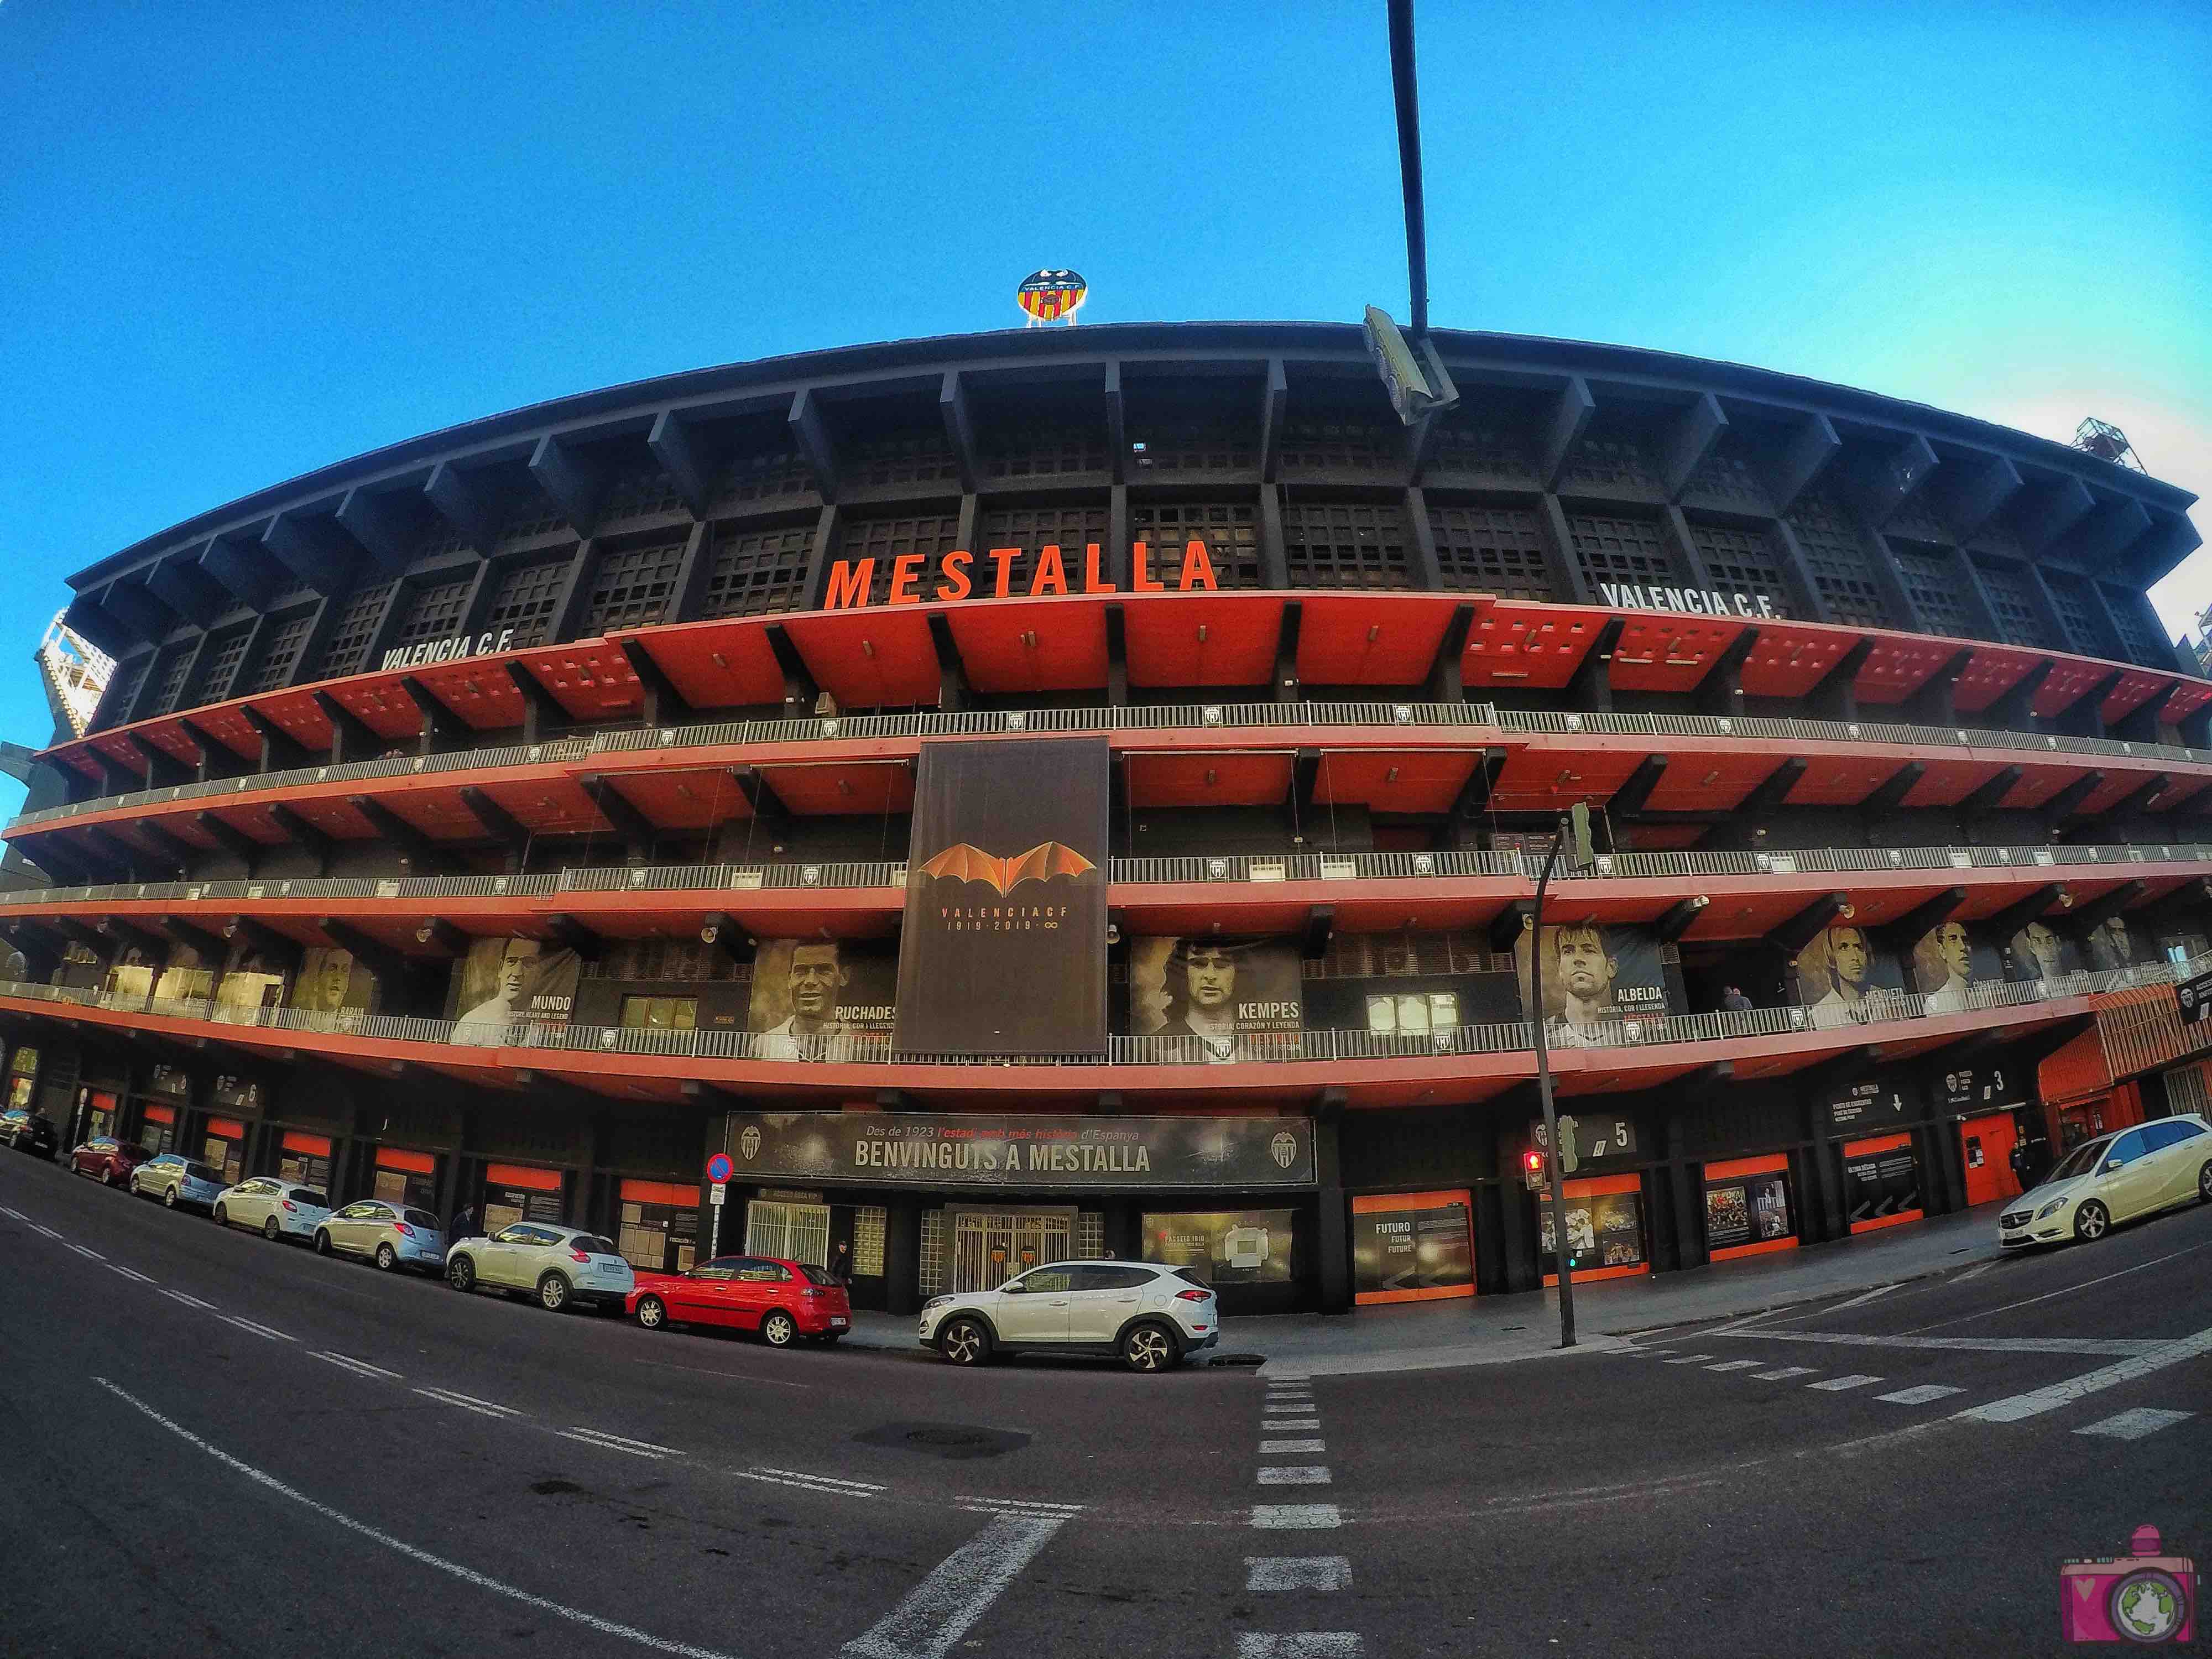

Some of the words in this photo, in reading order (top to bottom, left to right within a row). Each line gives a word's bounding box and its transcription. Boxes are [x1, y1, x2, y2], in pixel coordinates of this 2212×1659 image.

[824, 541, 1218, 609] MESTALLA
[1599, 583, 1730, 615] VALENCIA
[1734, 593, 1783, 619] C.F.
[381, 636, 471, 671] VALENCIA
[476, 629, 513, 656] C.F.
[531, 995, 571, 1011] MUNDO
[1618, 987, 1662, 1002] ALBELDA
[1239, 1002, 1299, 1019] KEMPES
[1994, 1071, 2004, 1091] 3
[866, 1125, 885, 1136] Des
[889, 1126, 901, 1136] de
[905, 1127, 933, 1138] 1923
[1082, 1129, 1139, 1142] d'Espanya
[1616, 1122, 1627, 1146] 5
[855, 1140, 997, 1170] BENVINGUTS
[1006, 1144, 1020, 1171] A
[1030, 1145, 1150, 1172] MESTALLA
[1376, 1222, 1410, 1234] FUTURO
[1391, 1235, 1411, 1243] FUTUR
[1388, 1245, 1411, 1253] FUTURE
